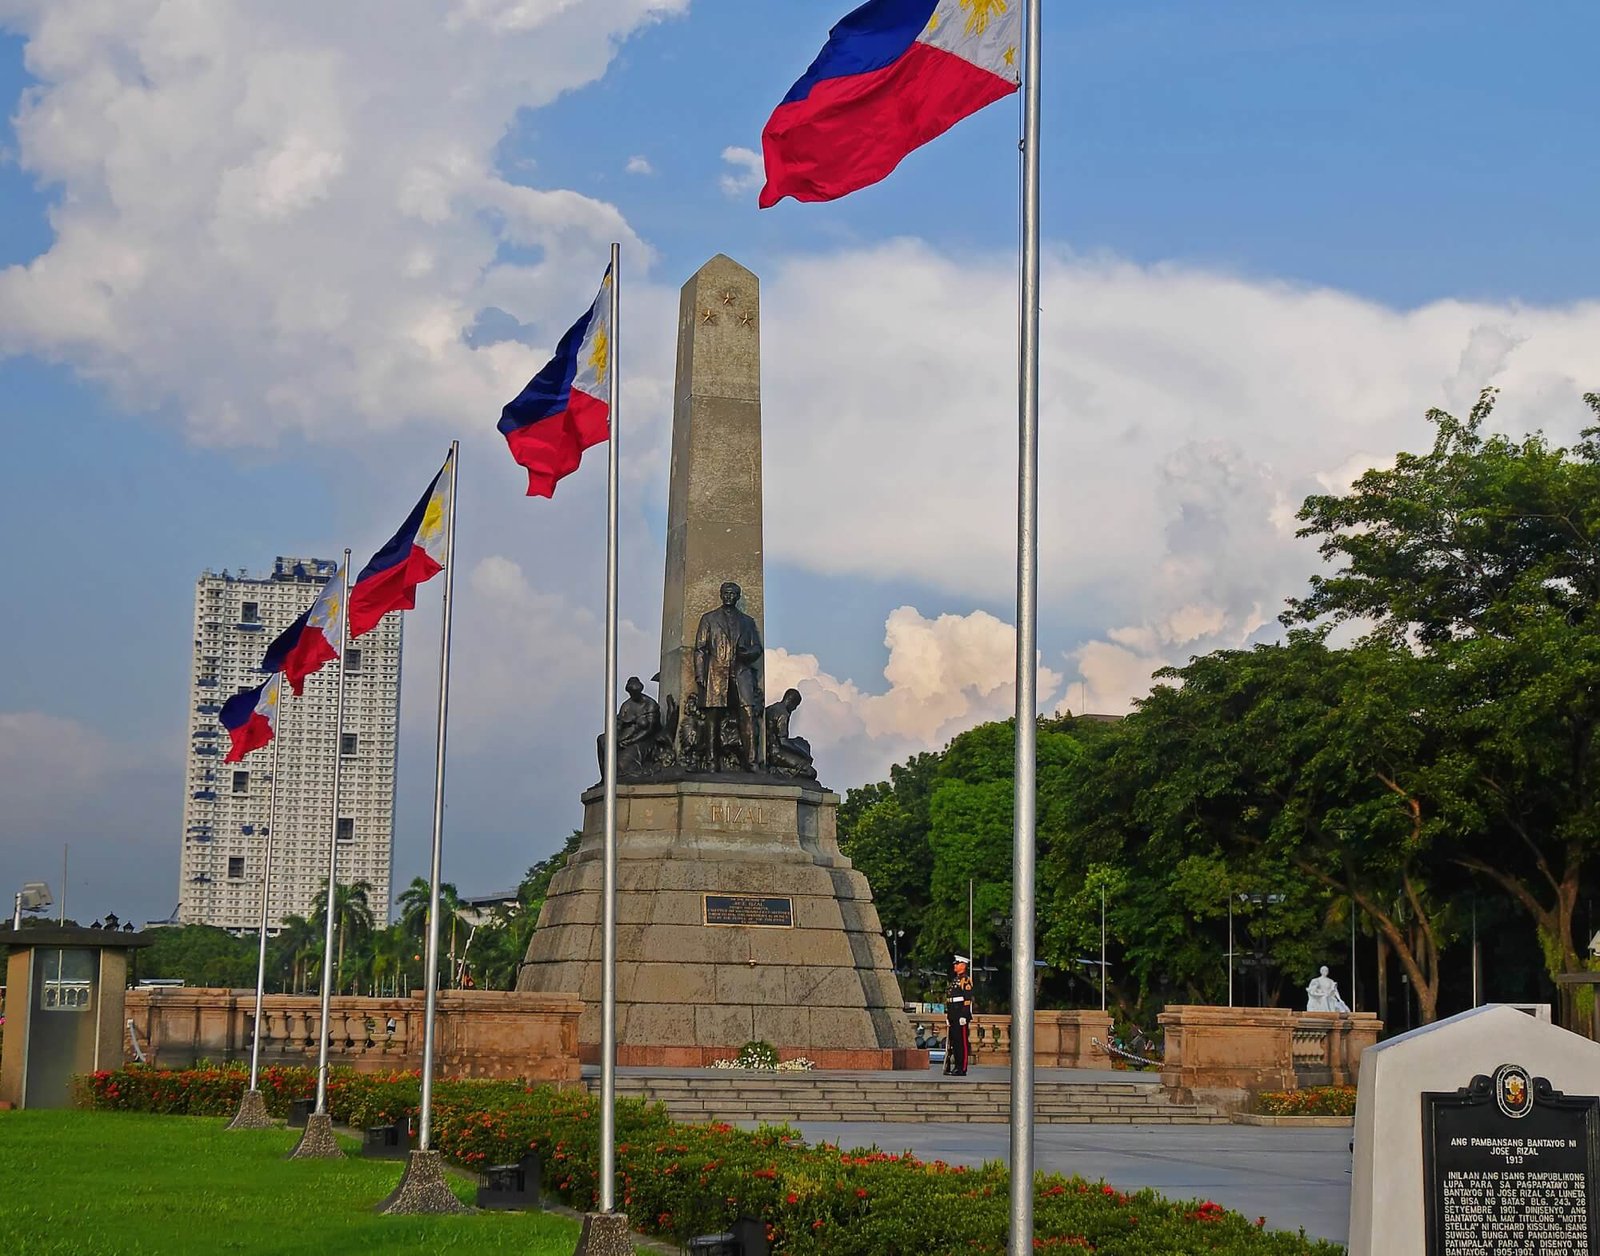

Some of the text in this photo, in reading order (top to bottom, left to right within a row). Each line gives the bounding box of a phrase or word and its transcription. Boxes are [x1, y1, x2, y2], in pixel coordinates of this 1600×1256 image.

[712, 806, 768, 824] RIZAL
[1451, 1138, 1467, 1146] ANG
[1471, 1139, 1523, 1147] PAMBANSANG
[1527, 1139, 1565, 1147] BANTAYOG
[1506, 1156, 1523, 1164] 1913
[1449, 1172, 1479, 1180] INILAAN
[1482, 1172, 1498, 1180] ANG
[1528, 1173, 1584, 1181] PAMPUBLIKONG
[1517, 1181, 1568, 1189] PAGPAPATAYO
[1444, 1189, 1482, 1197] BANTAYOG
[1487, 1189, 1493, 1197] NI
[1445, 1206, 1492, 1214] SETYEMBRE
[1482, 1223, 1489, 1231] NI
[1492, 1223, 1524, 1231] RICHARD
